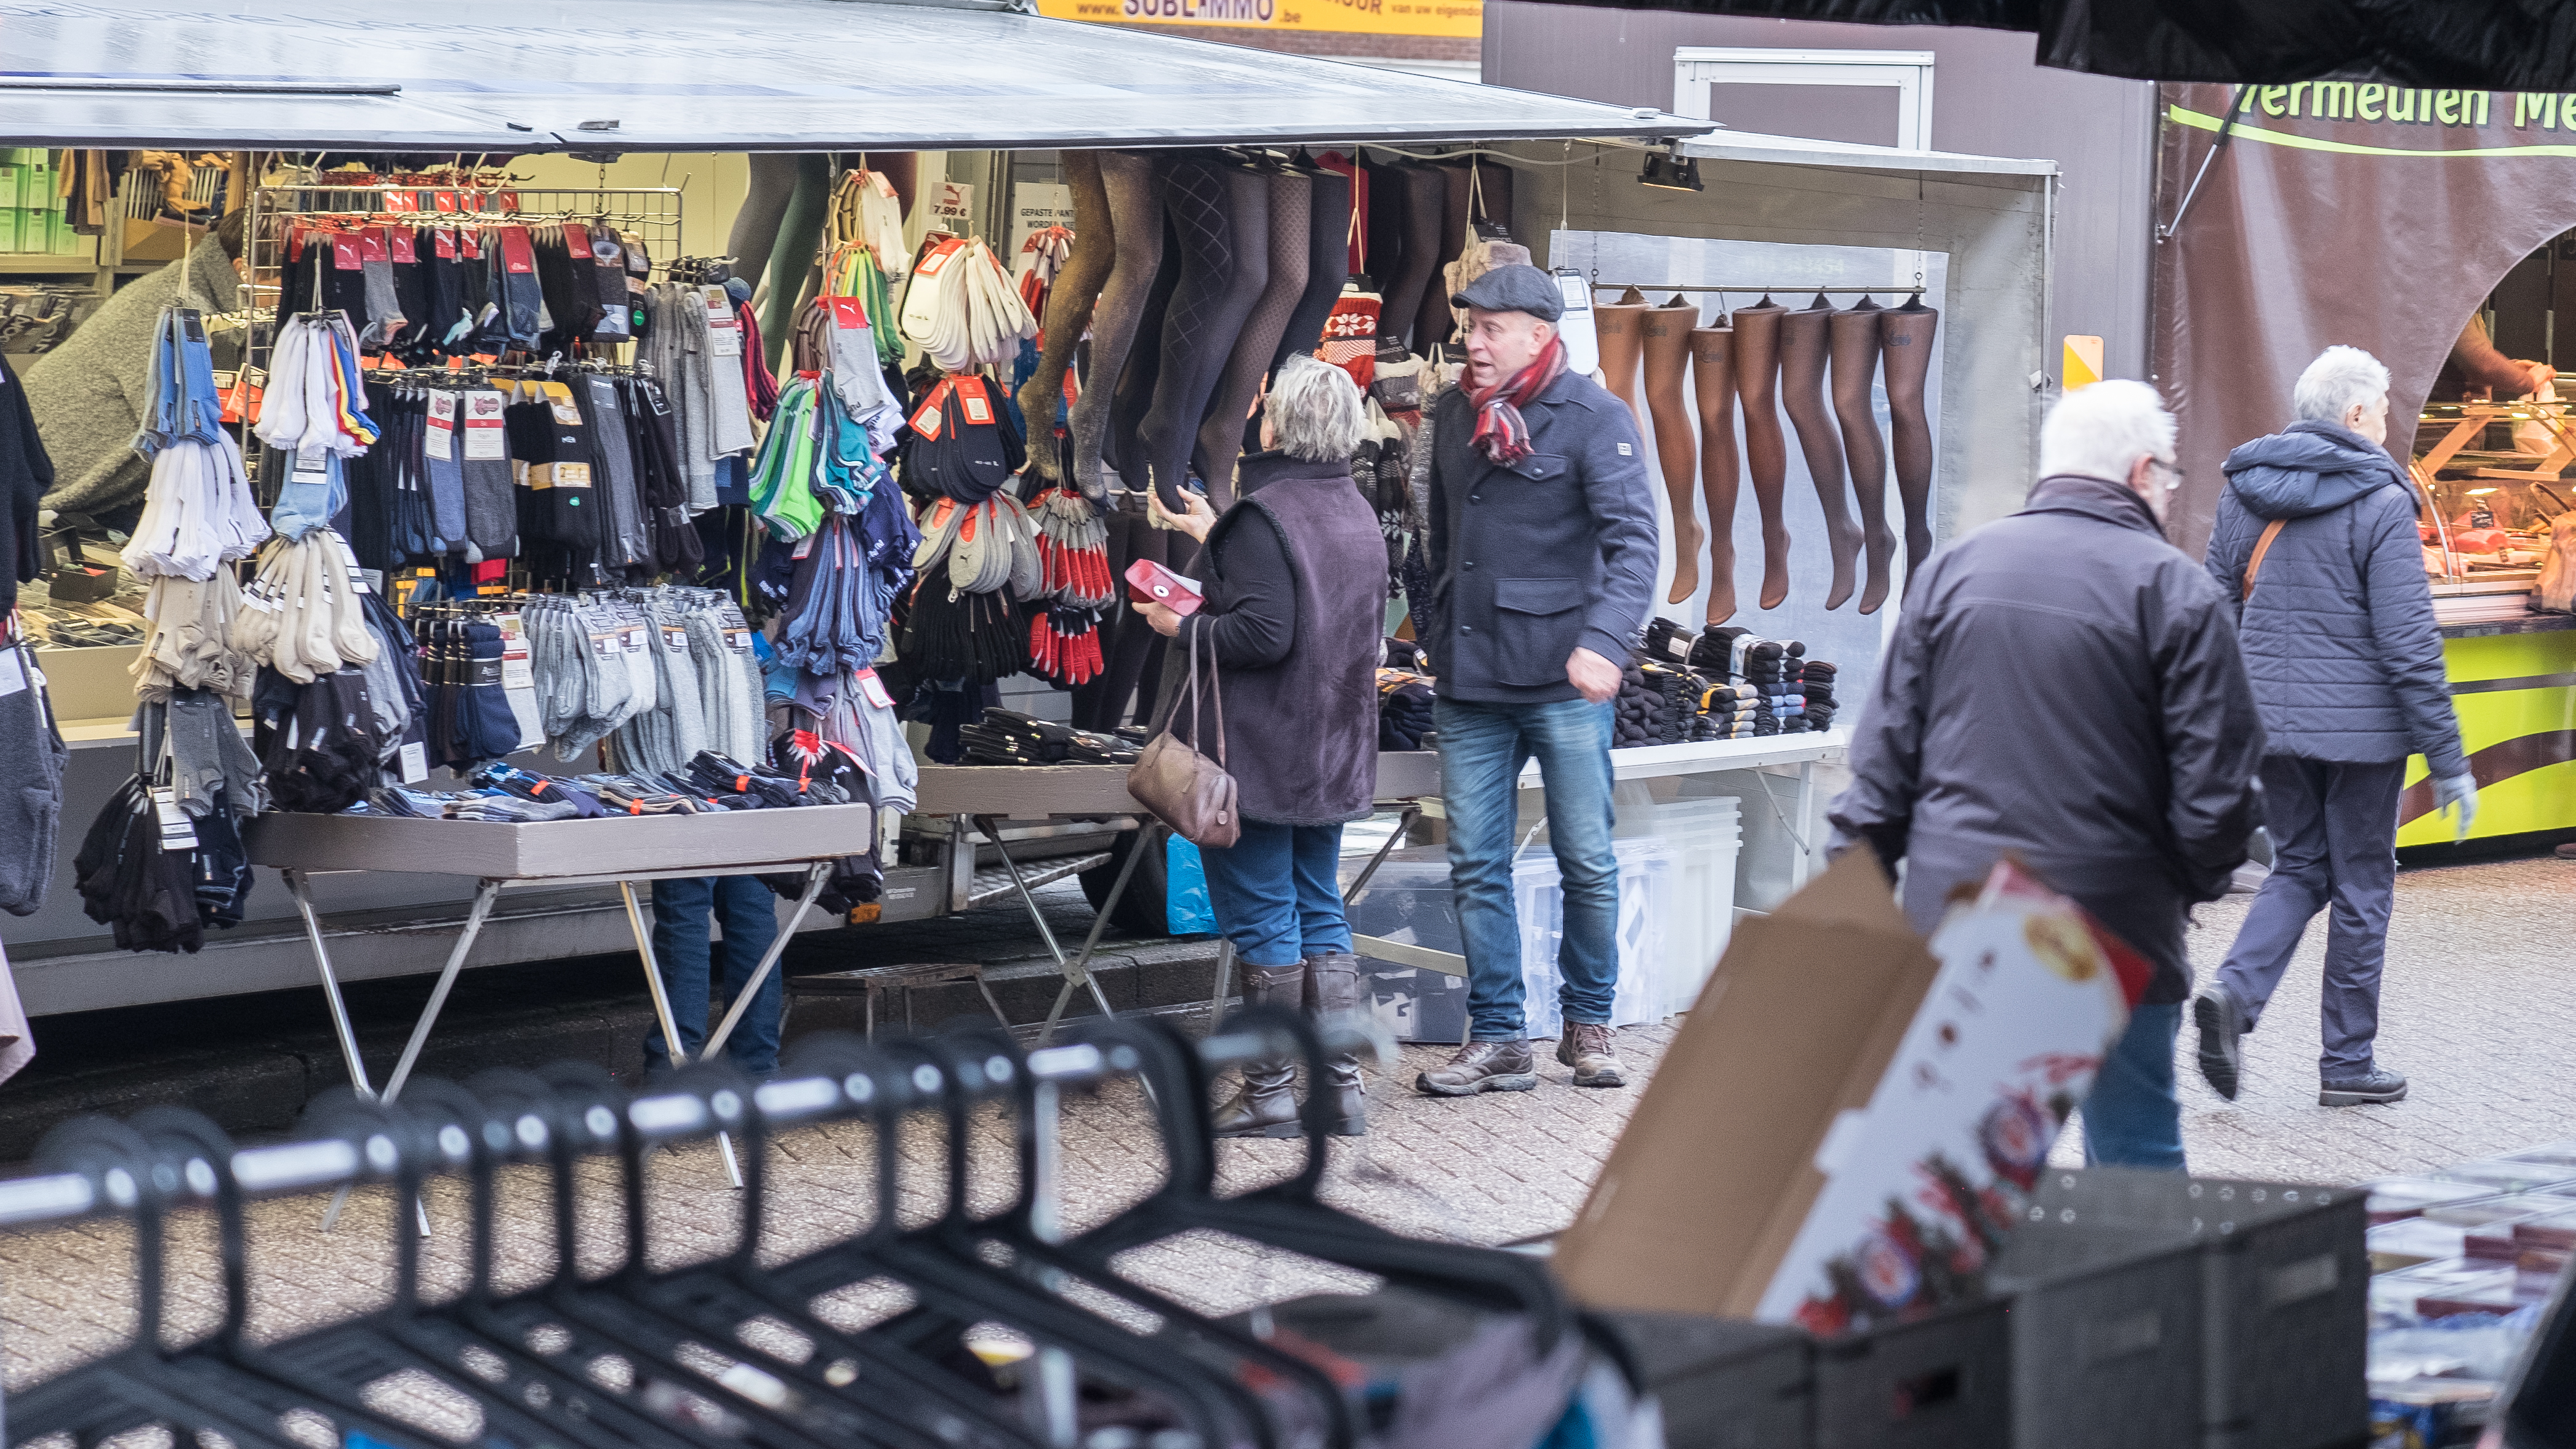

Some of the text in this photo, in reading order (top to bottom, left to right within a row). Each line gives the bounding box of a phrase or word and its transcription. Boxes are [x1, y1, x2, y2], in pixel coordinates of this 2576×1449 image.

[1078, 4, 1119, 15] www.
[1279, 9, 1301, 23] .be
[1391, 5, 1411, 14] van
[1416, 6, 1430, 14] uw
[934, 205, 966, 216] 7.99 €
[1021, 208, 1053, 217] GEPASTE
[1027, 220, 1059, 228] WORDE
